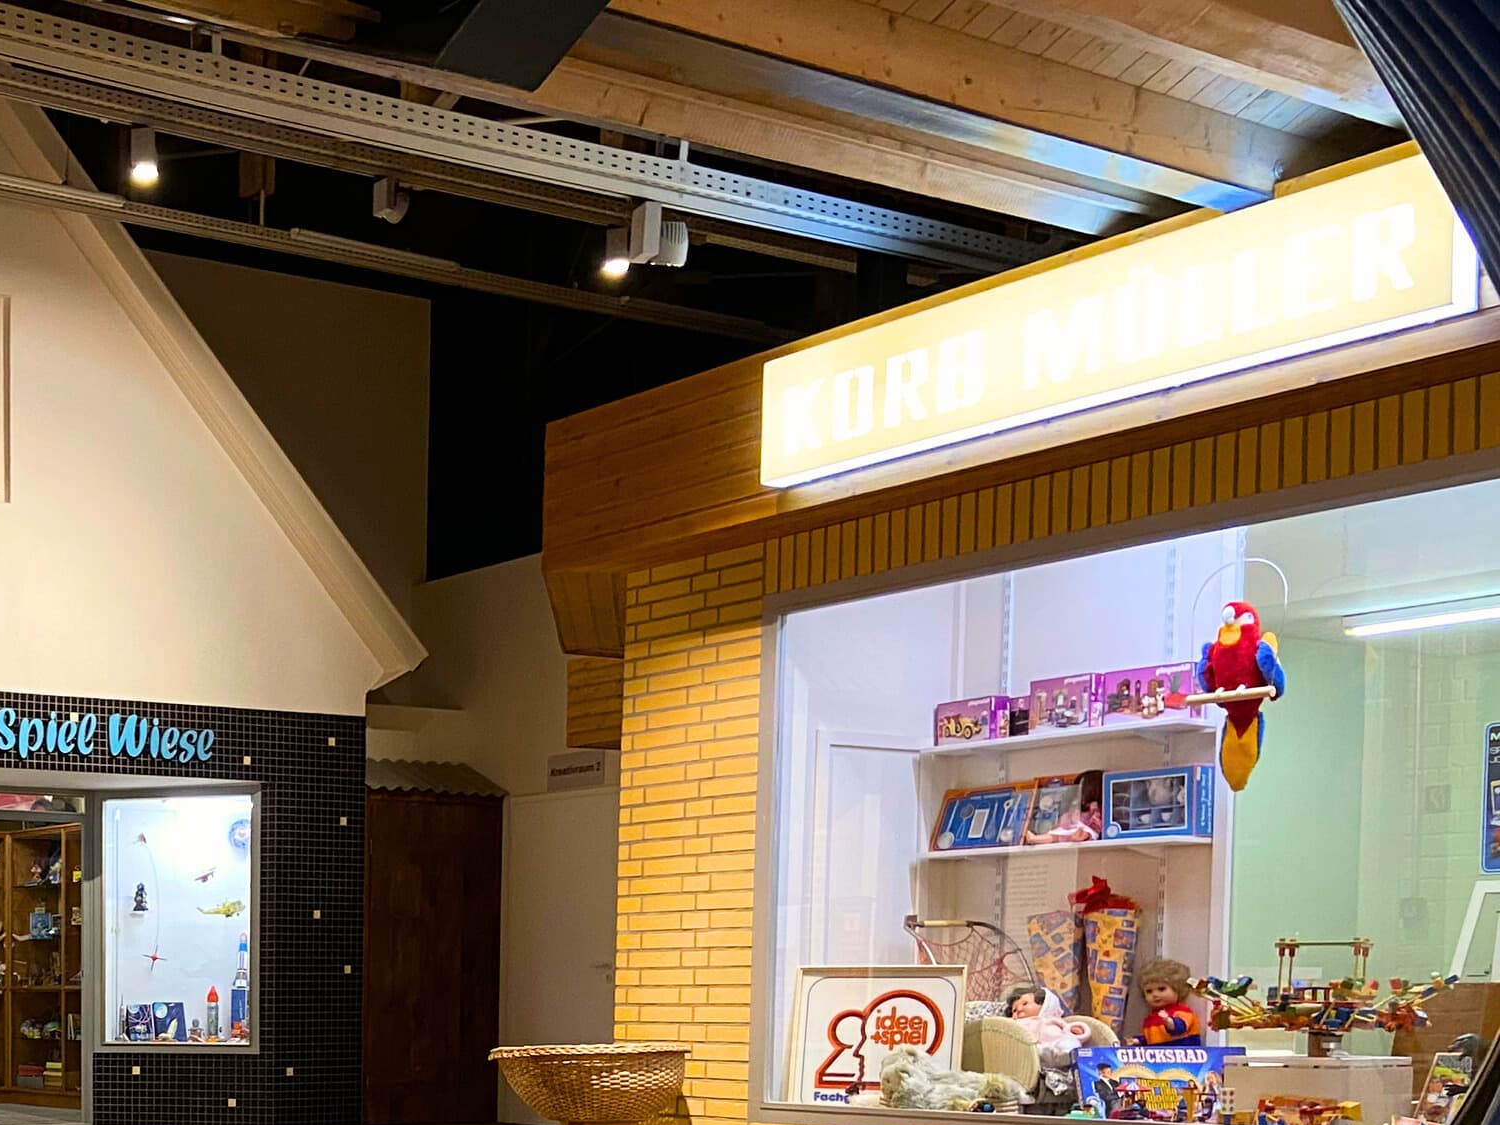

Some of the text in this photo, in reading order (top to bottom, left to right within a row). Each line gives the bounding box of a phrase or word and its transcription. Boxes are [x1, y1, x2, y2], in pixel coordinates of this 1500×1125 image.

[782, 203, 1416, 457] KORB MÜLLER
[108, 713, 215, 764] Wiese
[875, 1006, 923, 1030] idee
[1116, 1046, 1208, 1064] GLÜCKSRAD
